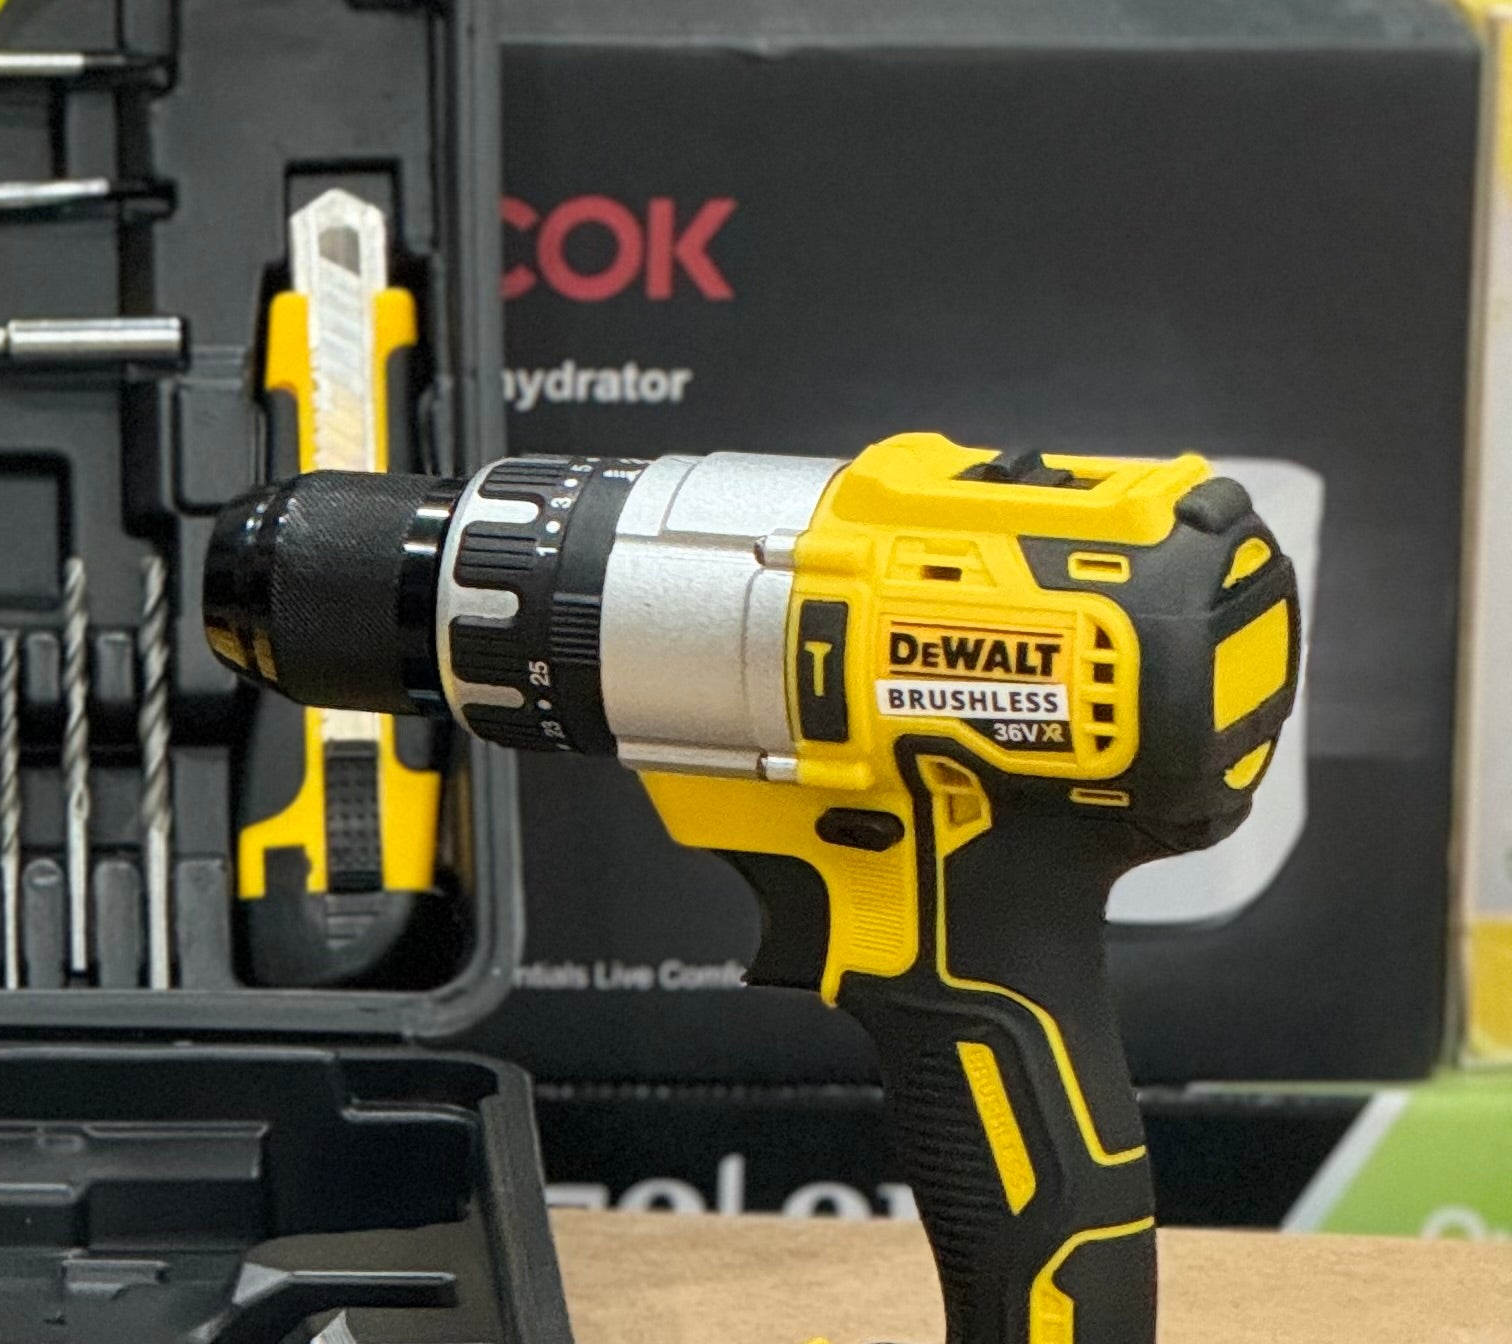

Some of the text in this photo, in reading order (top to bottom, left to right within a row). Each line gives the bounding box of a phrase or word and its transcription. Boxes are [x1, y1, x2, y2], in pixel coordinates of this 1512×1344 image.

[550, 496, 573, 509] 3
[528, 660, 552, 688] 25
[887, 687, 1060, 715] BRUSHLESS
[993, 722, 1040, 744] 36V
[593, 960, 655, 992] Live
